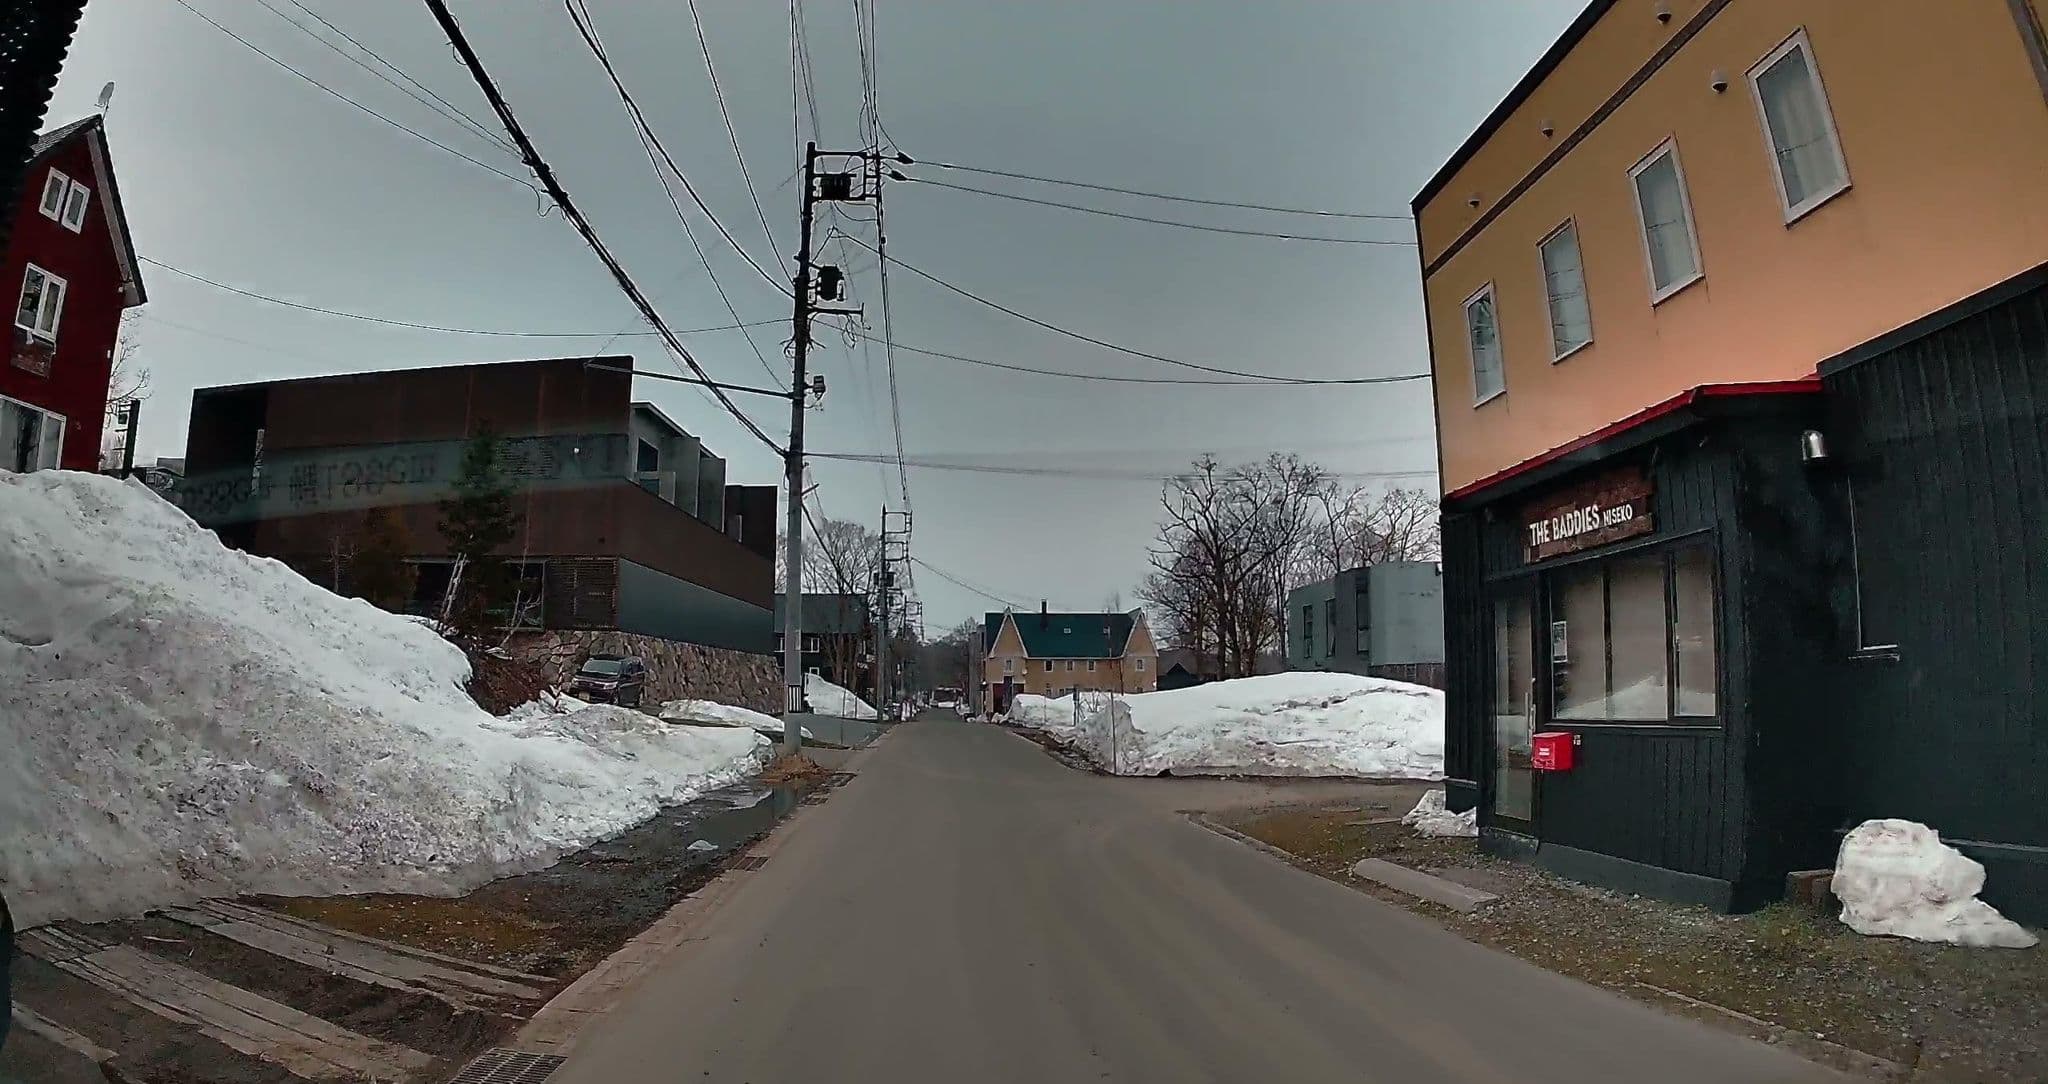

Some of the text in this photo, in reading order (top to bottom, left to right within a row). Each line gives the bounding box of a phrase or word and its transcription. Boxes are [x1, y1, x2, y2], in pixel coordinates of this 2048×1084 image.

[1529, 504, 1633, 547] THE BADDIES NISEKO
